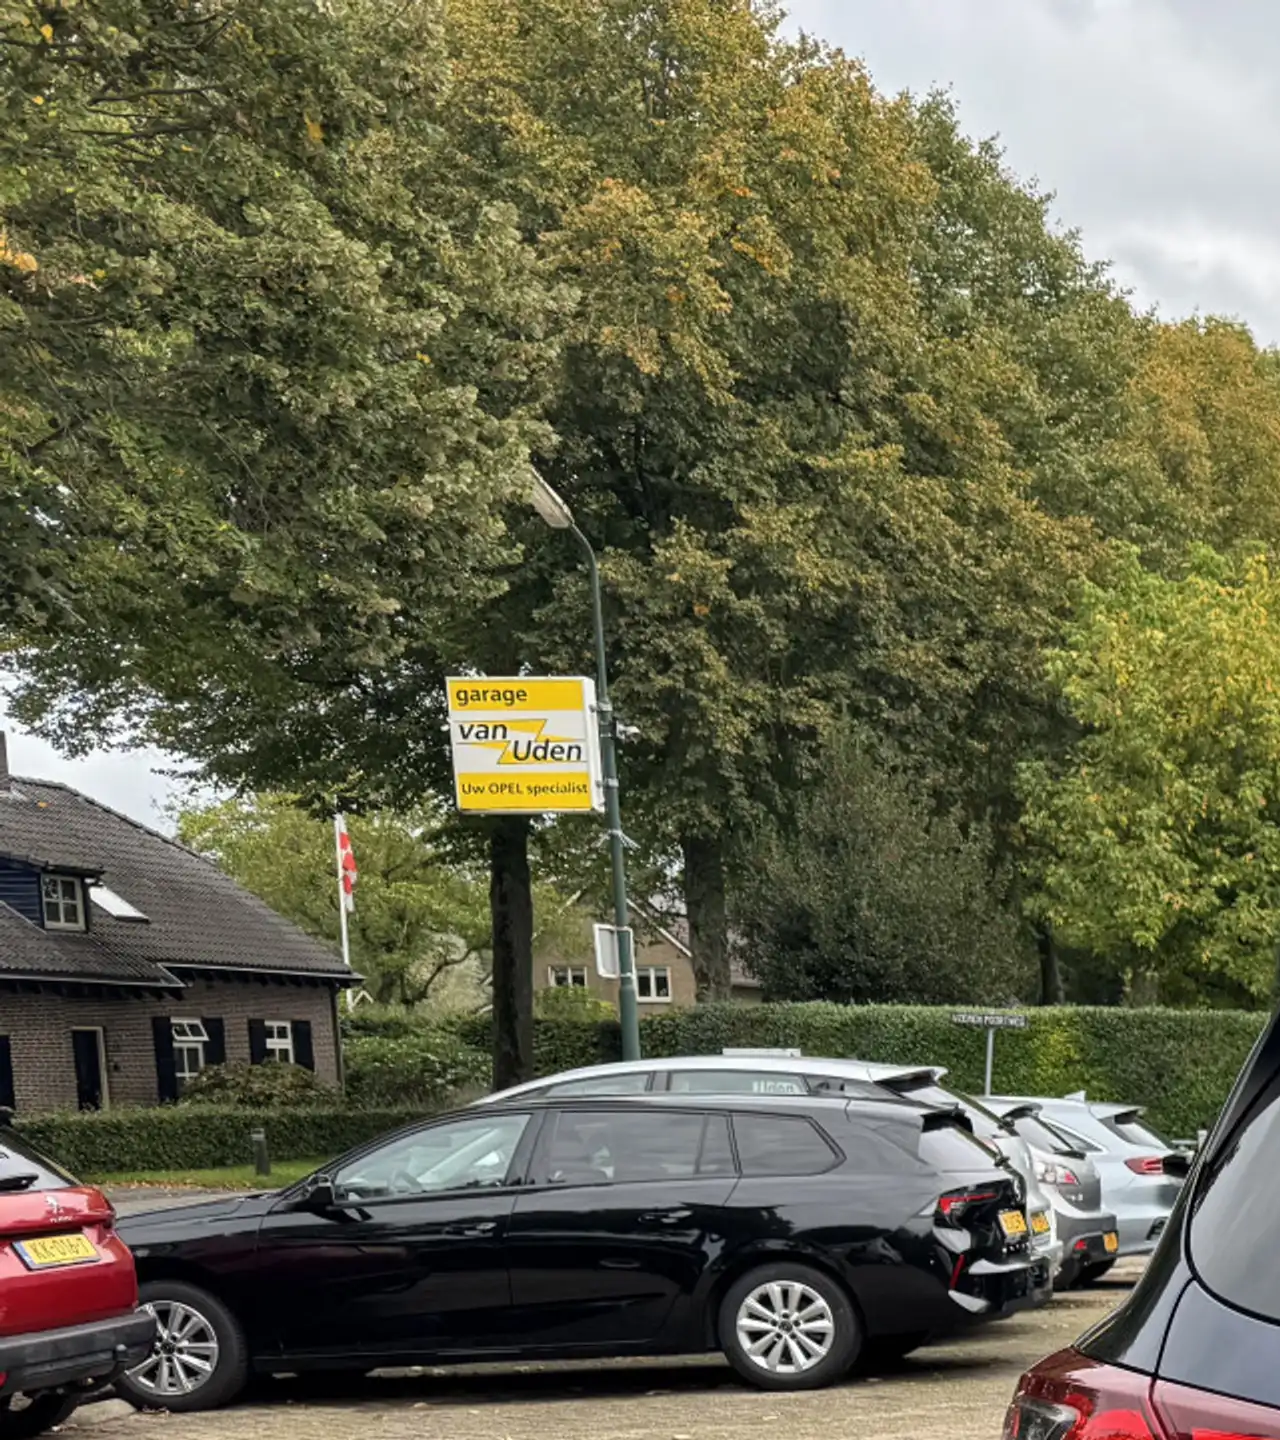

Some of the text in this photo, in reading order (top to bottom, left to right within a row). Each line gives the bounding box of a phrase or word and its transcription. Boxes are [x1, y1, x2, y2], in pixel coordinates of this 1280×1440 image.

[456, 685, 528, 706] garage
[458, 722, 508, 740] van
[513, 740, 582, 762] Uden
[461, 782, 588, 797] Uw OPEL specialist
